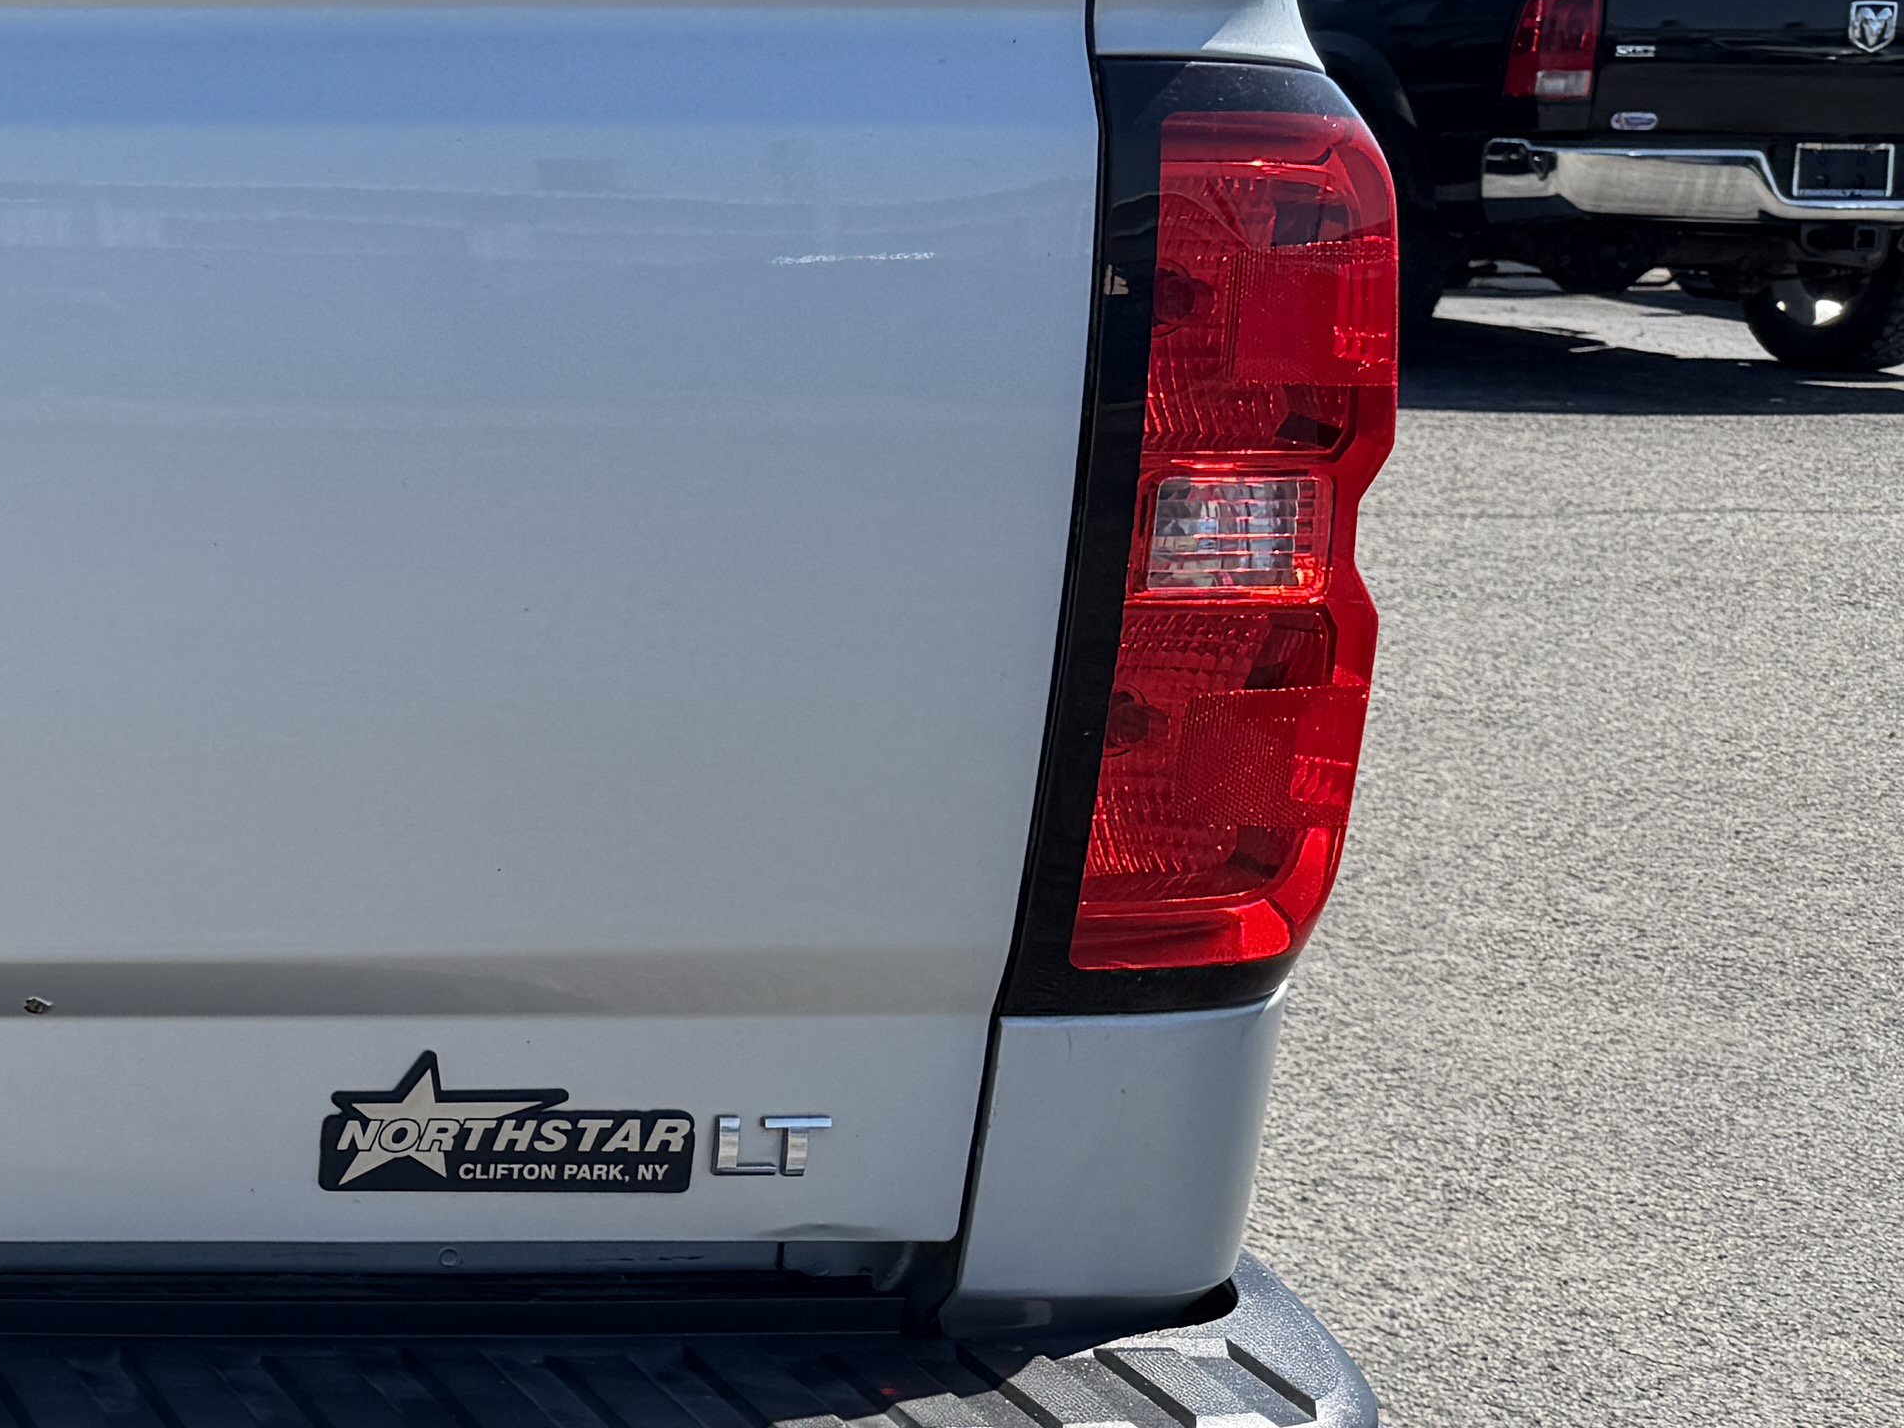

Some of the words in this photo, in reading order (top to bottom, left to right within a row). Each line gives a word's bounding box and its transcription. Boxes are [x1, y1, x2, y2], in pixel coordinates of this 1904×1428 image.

[336, 1116, 695, 1154] NORTHSTAR
[711, 1113, 834, 1179] LT
[458, 1161, 557, 1182] CLIFTON
[562, 1162, 630, 1185] PARK,
[636, 1162, 669, 1183] NY
